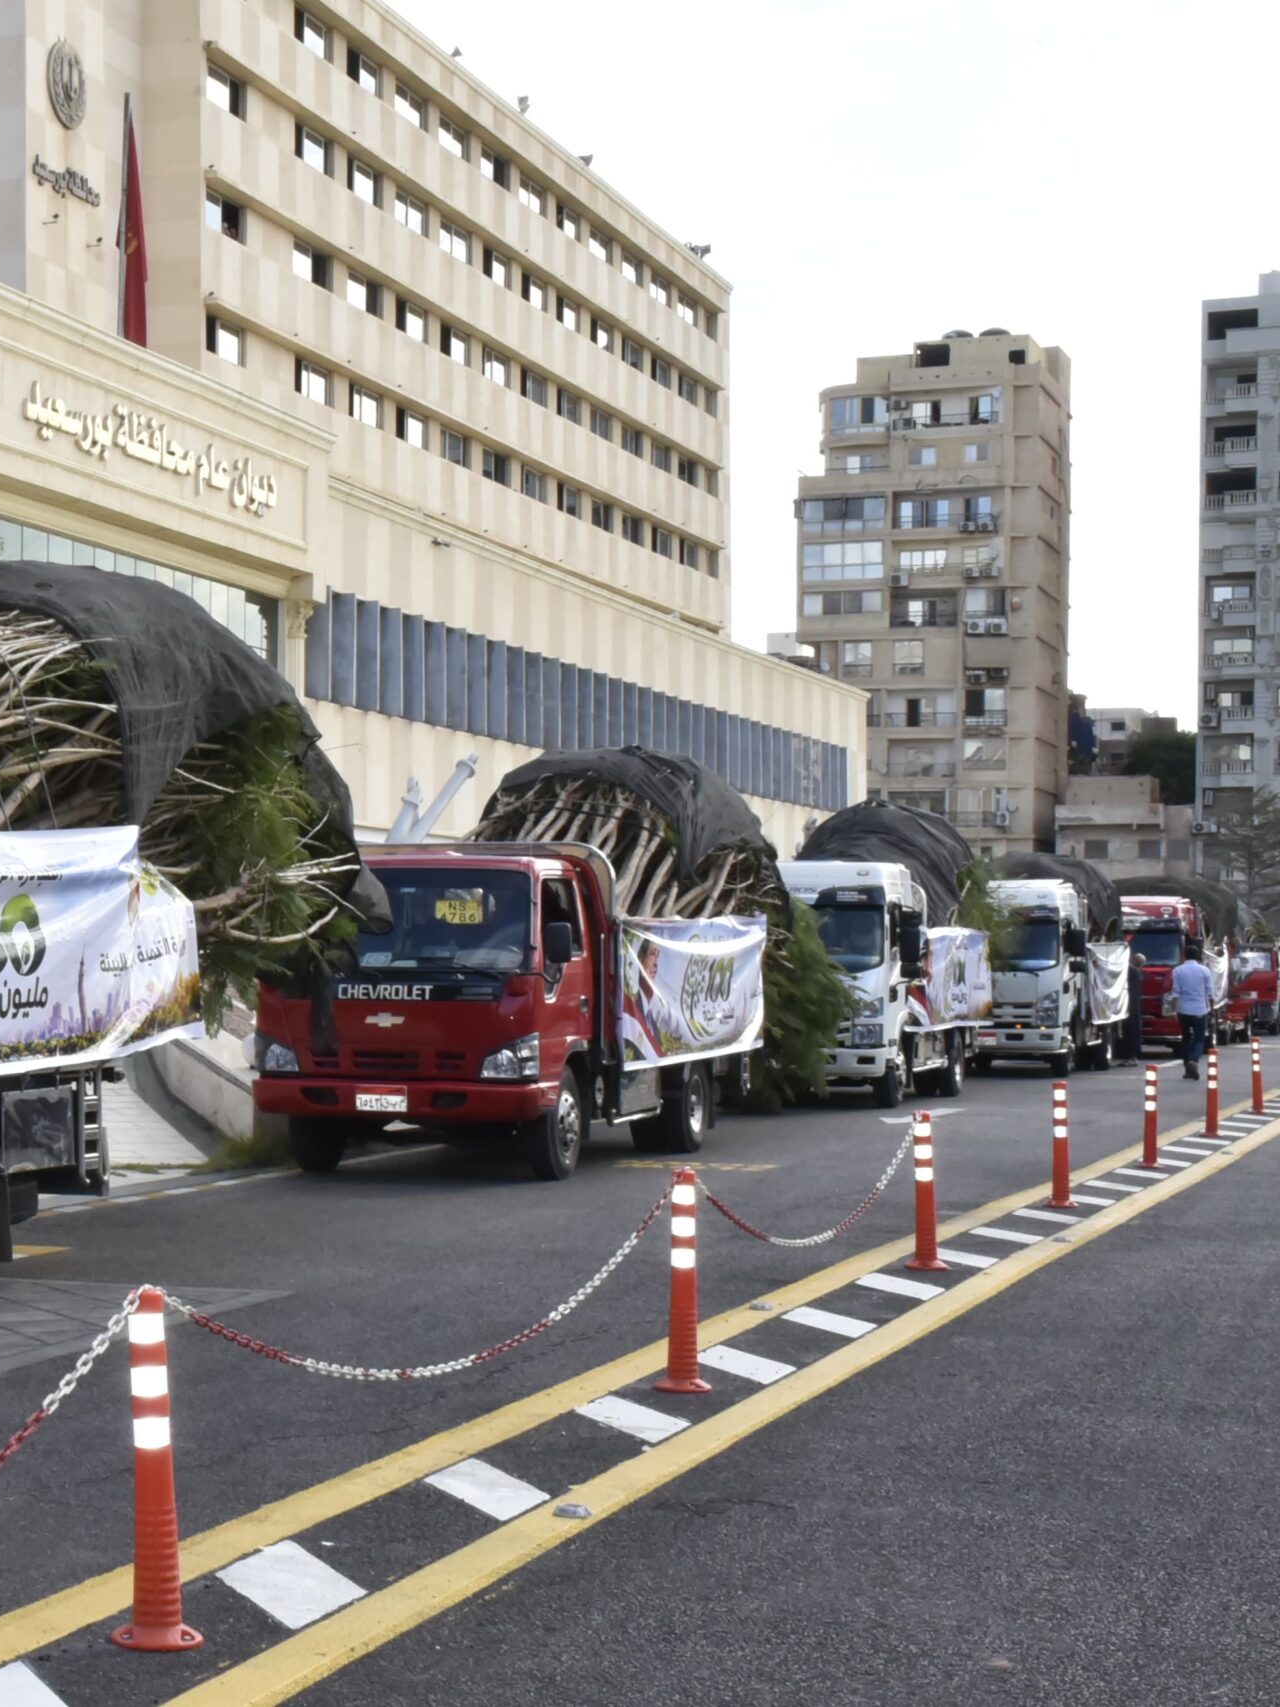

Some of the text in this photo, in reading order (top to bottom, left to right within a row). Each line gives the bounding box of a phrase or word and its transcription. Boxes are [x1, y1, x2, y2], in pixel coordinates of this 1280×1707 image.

[113, 403, 195, 476] محافظة
[194, 443, 231, 497] عام
[231, 456, 277, 518] ديوان
[448, 901, 466, 911] NS
[0, 976, 48, 1019] مليون
[337, 983, 434, 1001] CHEVROLET
